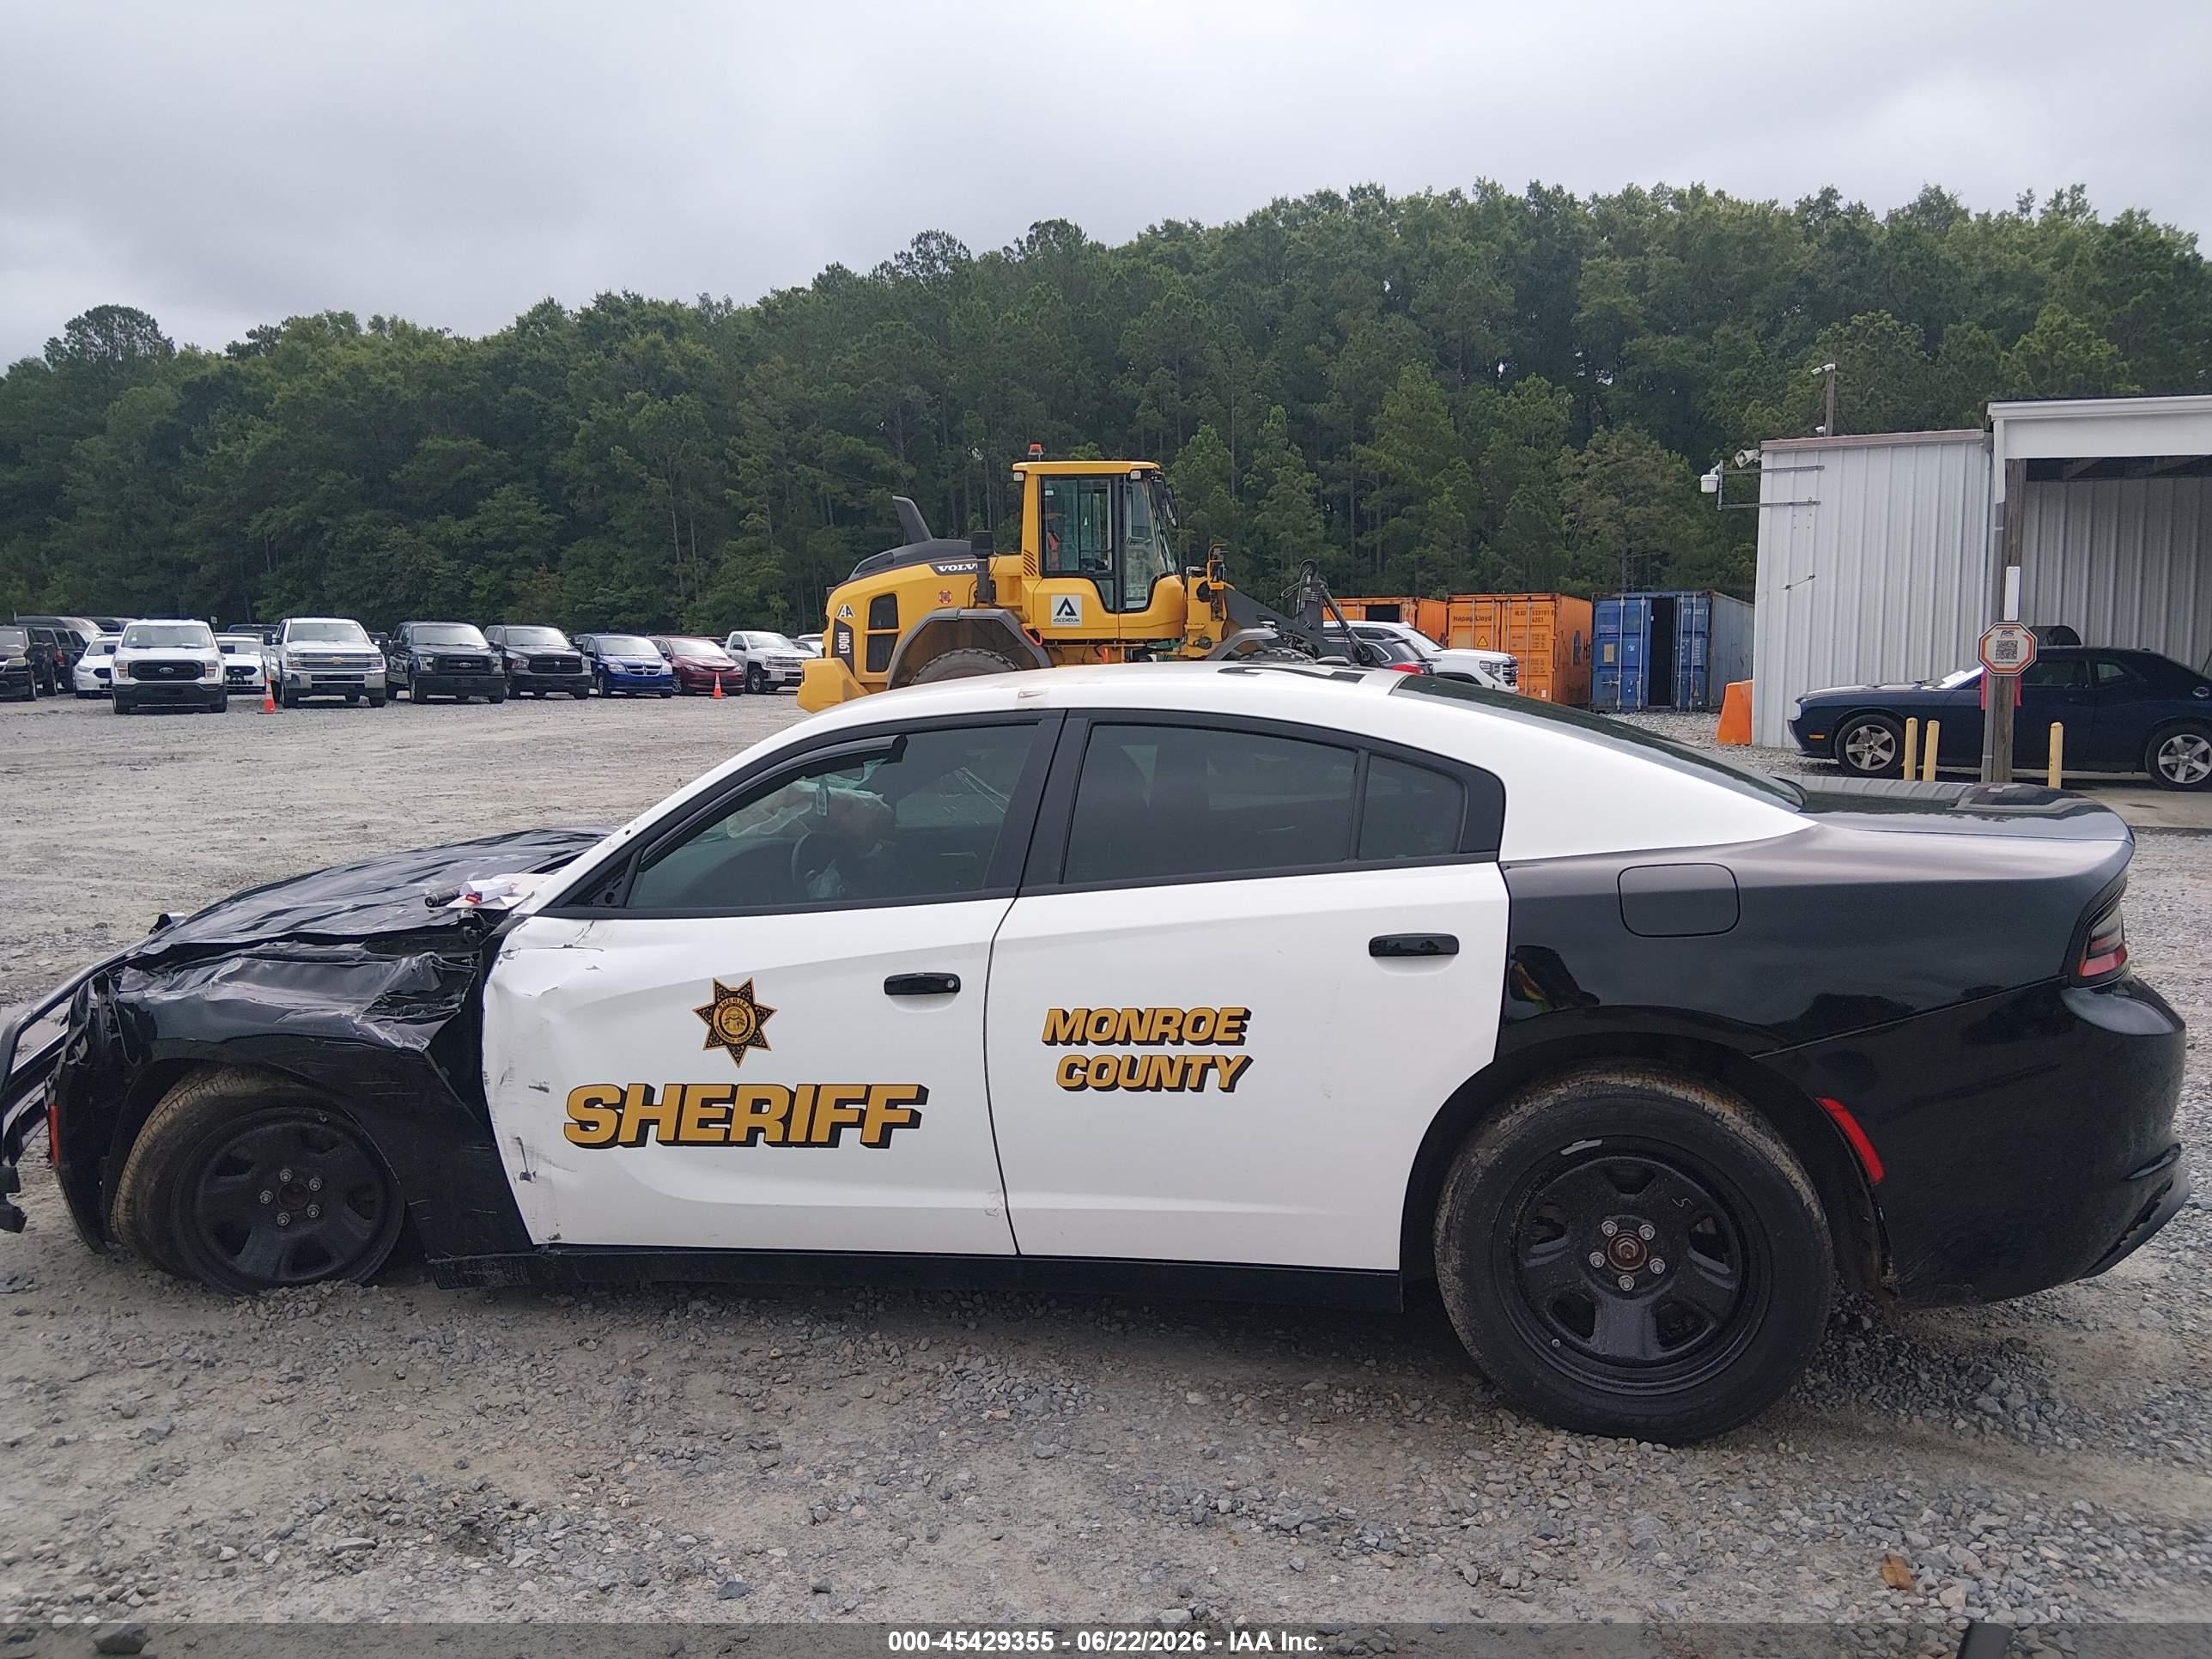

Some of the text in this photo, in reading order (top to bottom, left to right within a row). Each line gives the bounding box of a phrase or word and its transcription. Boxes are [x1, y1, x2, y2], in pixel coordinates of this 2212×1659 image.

[937, 562, 978, 572] VOLV
[838, 632, 850, 654] L90H
[1042, 1007, 1251, 1046] MONROE
[1056, 1054, 1254, 1092] COUNTY
[563, 1083, 929, 1149] SHERIFF
